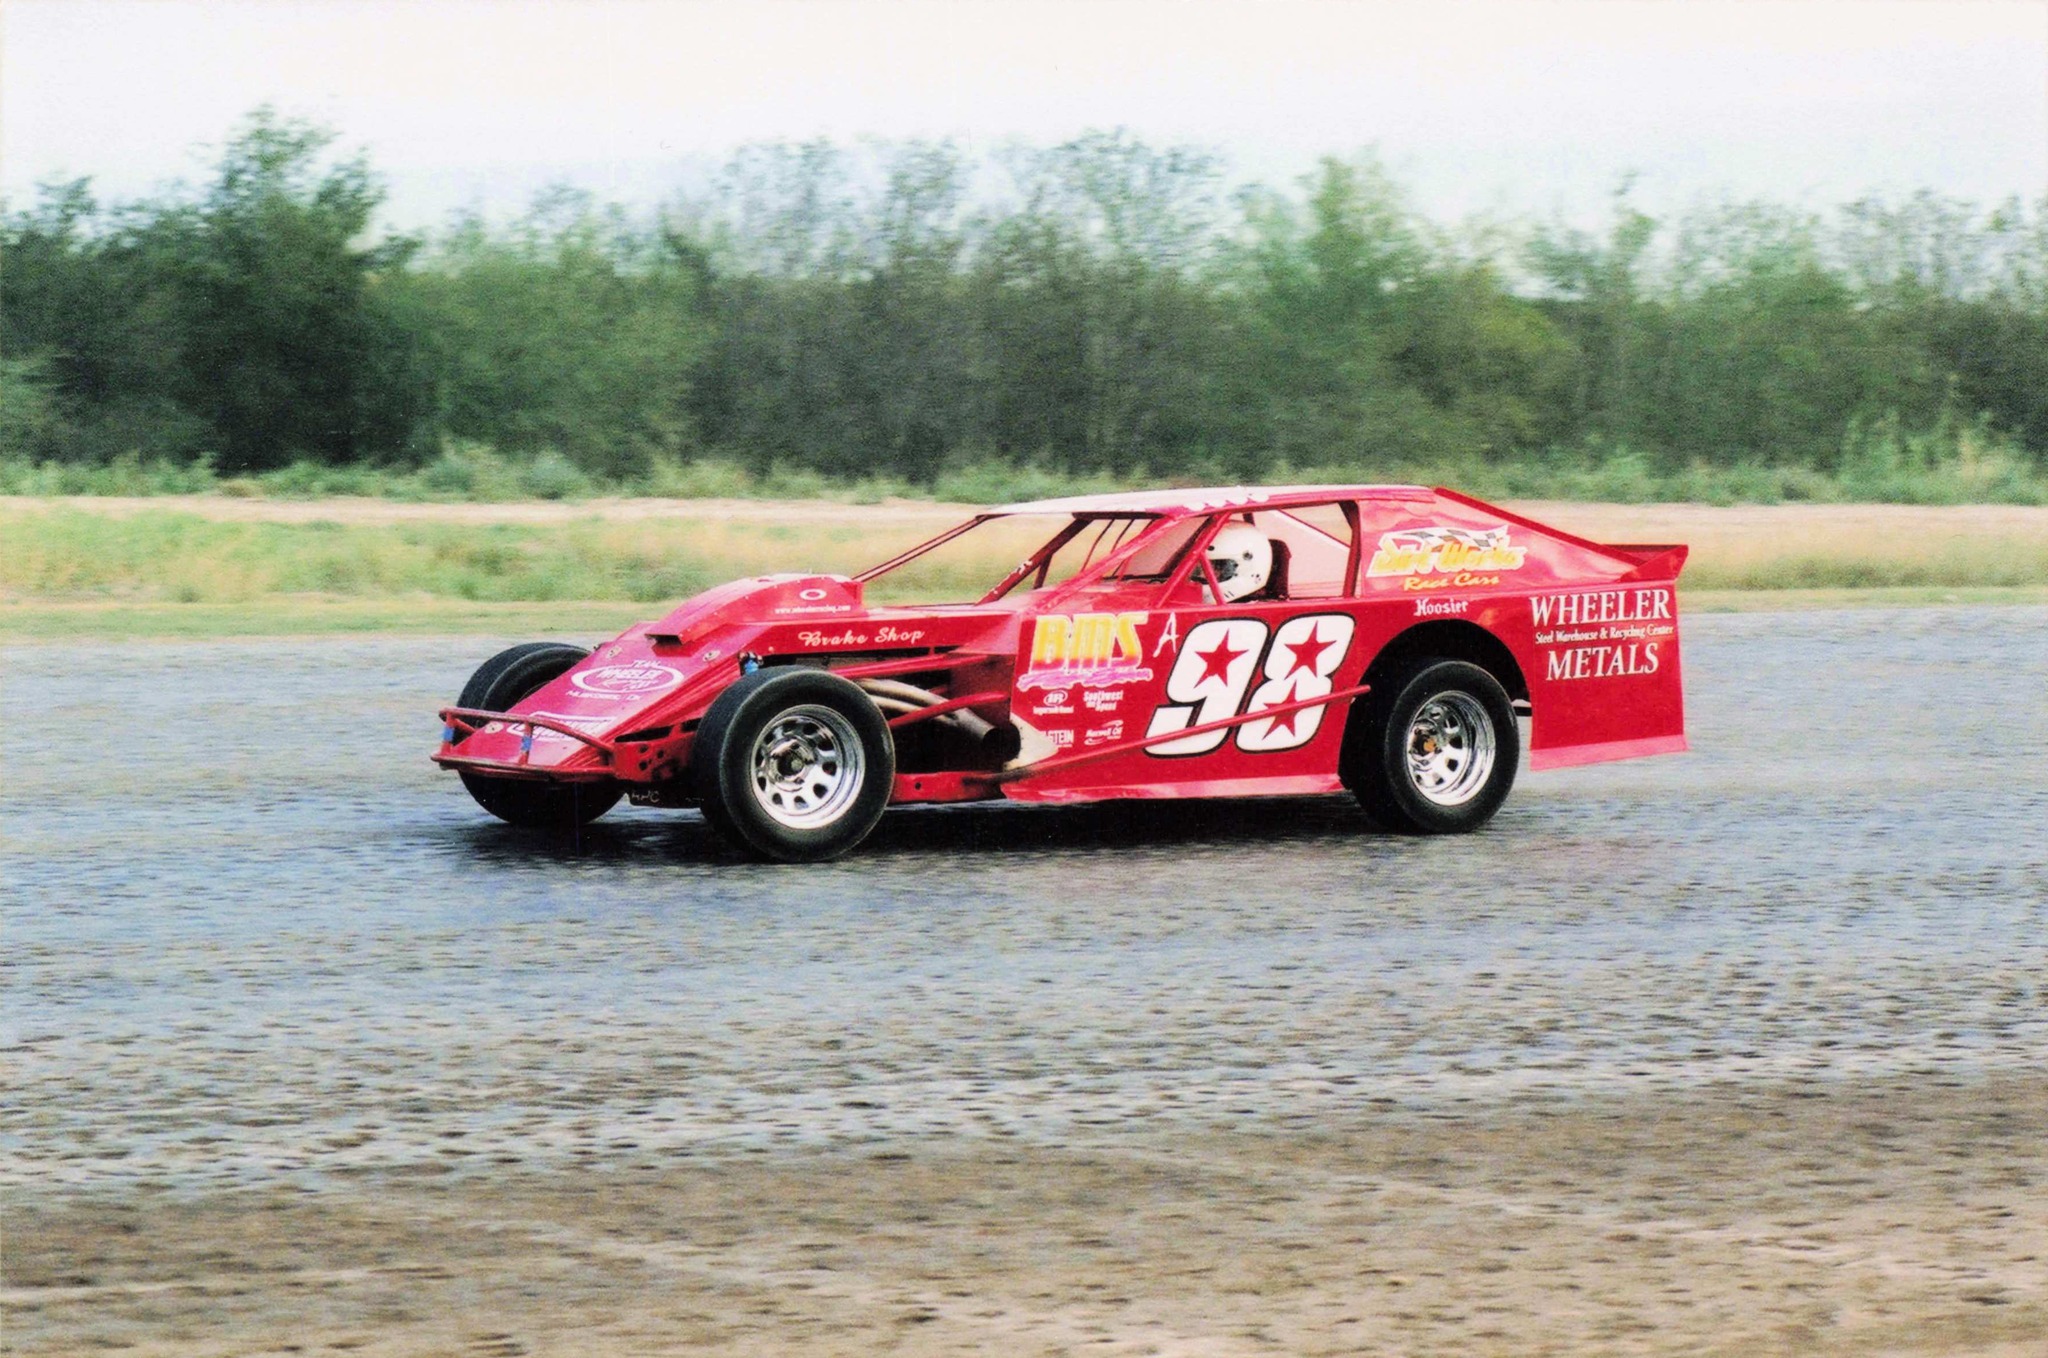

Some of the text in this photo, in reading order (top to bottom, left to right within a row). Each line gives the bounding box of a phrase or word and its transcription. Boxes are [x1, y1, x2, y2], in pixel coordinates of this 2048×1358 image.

[1403, 572, 1500, 591] Race Cars
[1414, 598, 1469, 616] Hoosier
[1529, 589, 1672, 628] WHEELER
[798, 626, 926, 647] Brake Shop
[1029, 611, 1149, 675] BMS
[1153, 612, 1180, 658] A
[1535, 623, 1674, 645] Steel Warehouse & Recycling Center
[1546, 642, 1660, 681] METALS
[1143, 611, 1357, 759] 98
